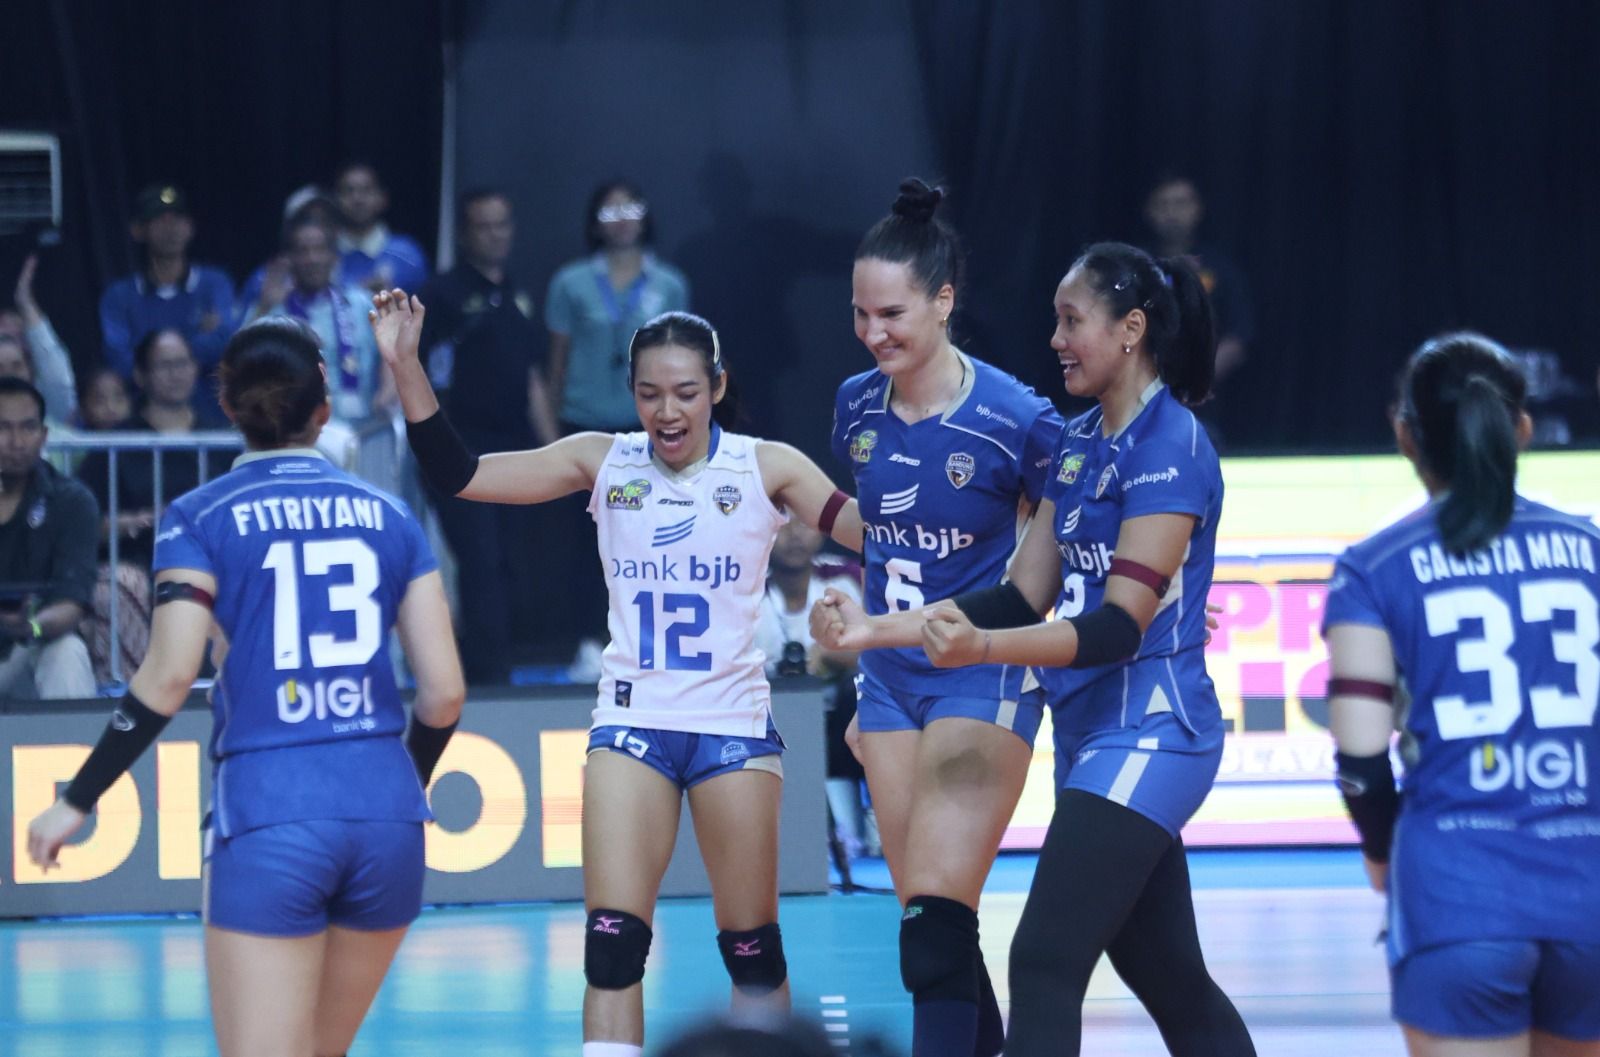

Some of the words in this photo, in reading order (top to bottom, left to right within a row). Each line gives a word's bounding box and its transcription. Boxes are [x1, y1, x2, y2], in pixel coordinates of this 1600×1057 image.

[231, 496, 384, 535] FITRIYANI
[864, 520, 911, 548] ank
[914, 524, 974, 559] bjb
[689, 556, 741, 589] bjb
[1525, 531, 1596, 573] MAYA
[262, 538, 381, 670] 13
[884, 558, 925, 614] 6
[632, 590, 713, 671] 12
[1423, 578, 1600, 740] 33
